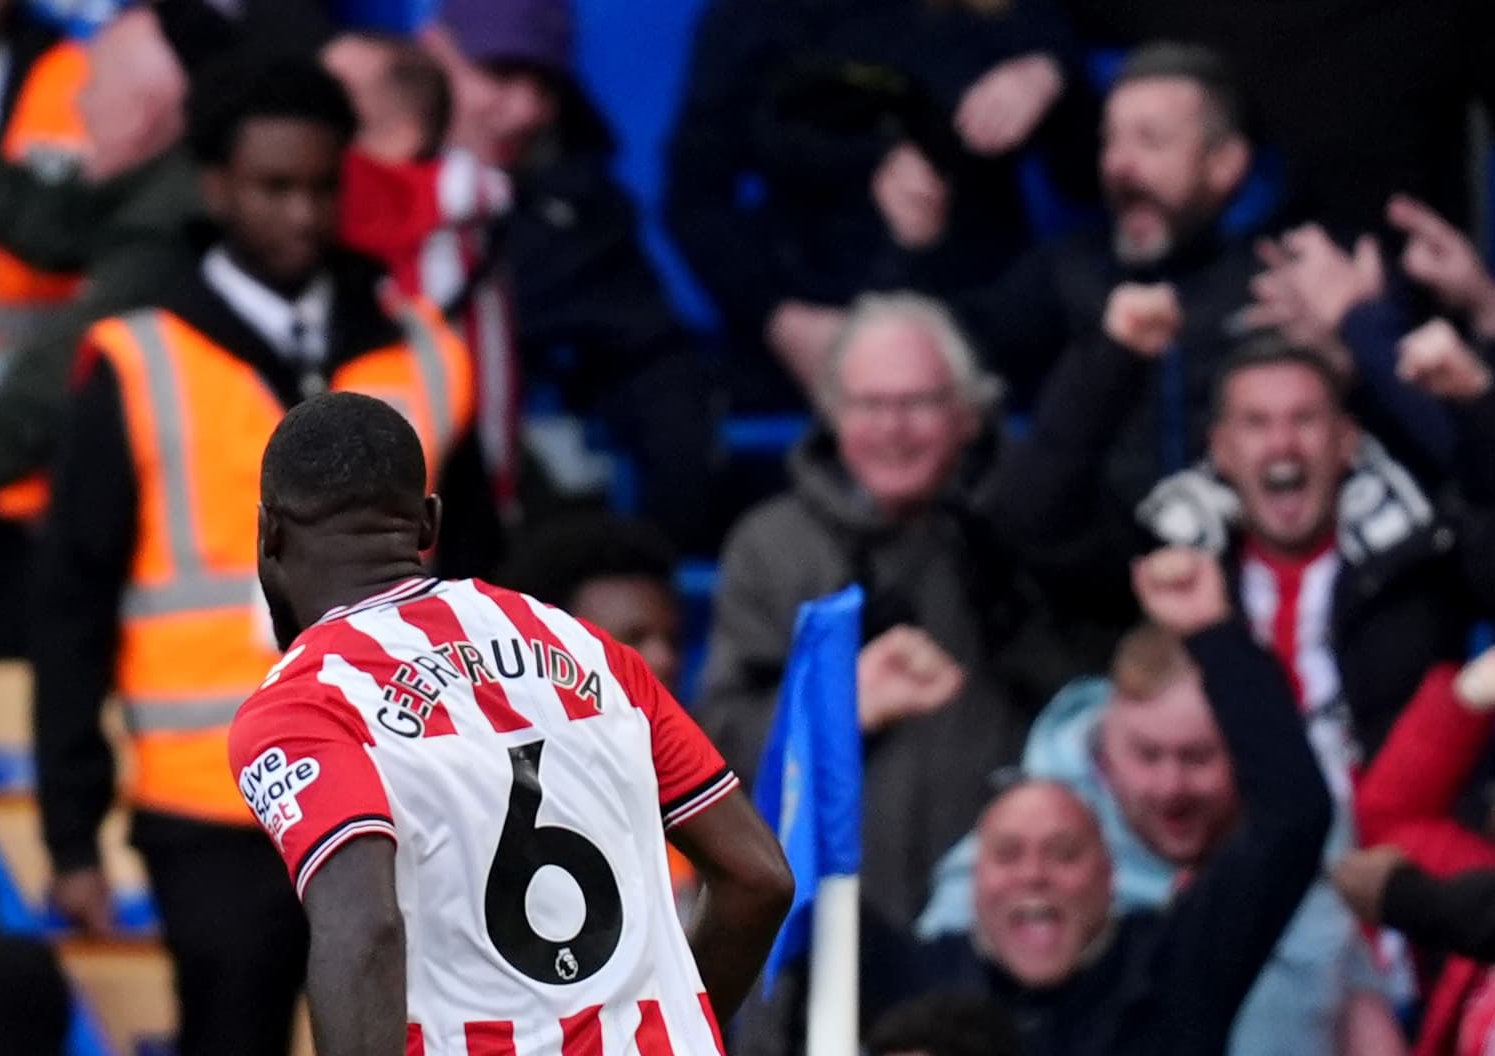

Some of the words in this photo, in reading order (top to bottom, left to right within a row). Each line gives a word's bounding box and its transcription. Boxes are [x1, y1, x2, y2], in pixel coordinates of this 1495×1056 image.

[377, 638, 604, 739] GEERTRUIDA
[241, 752, 282, 803] Live
[484, 738, 624, 986] 6
